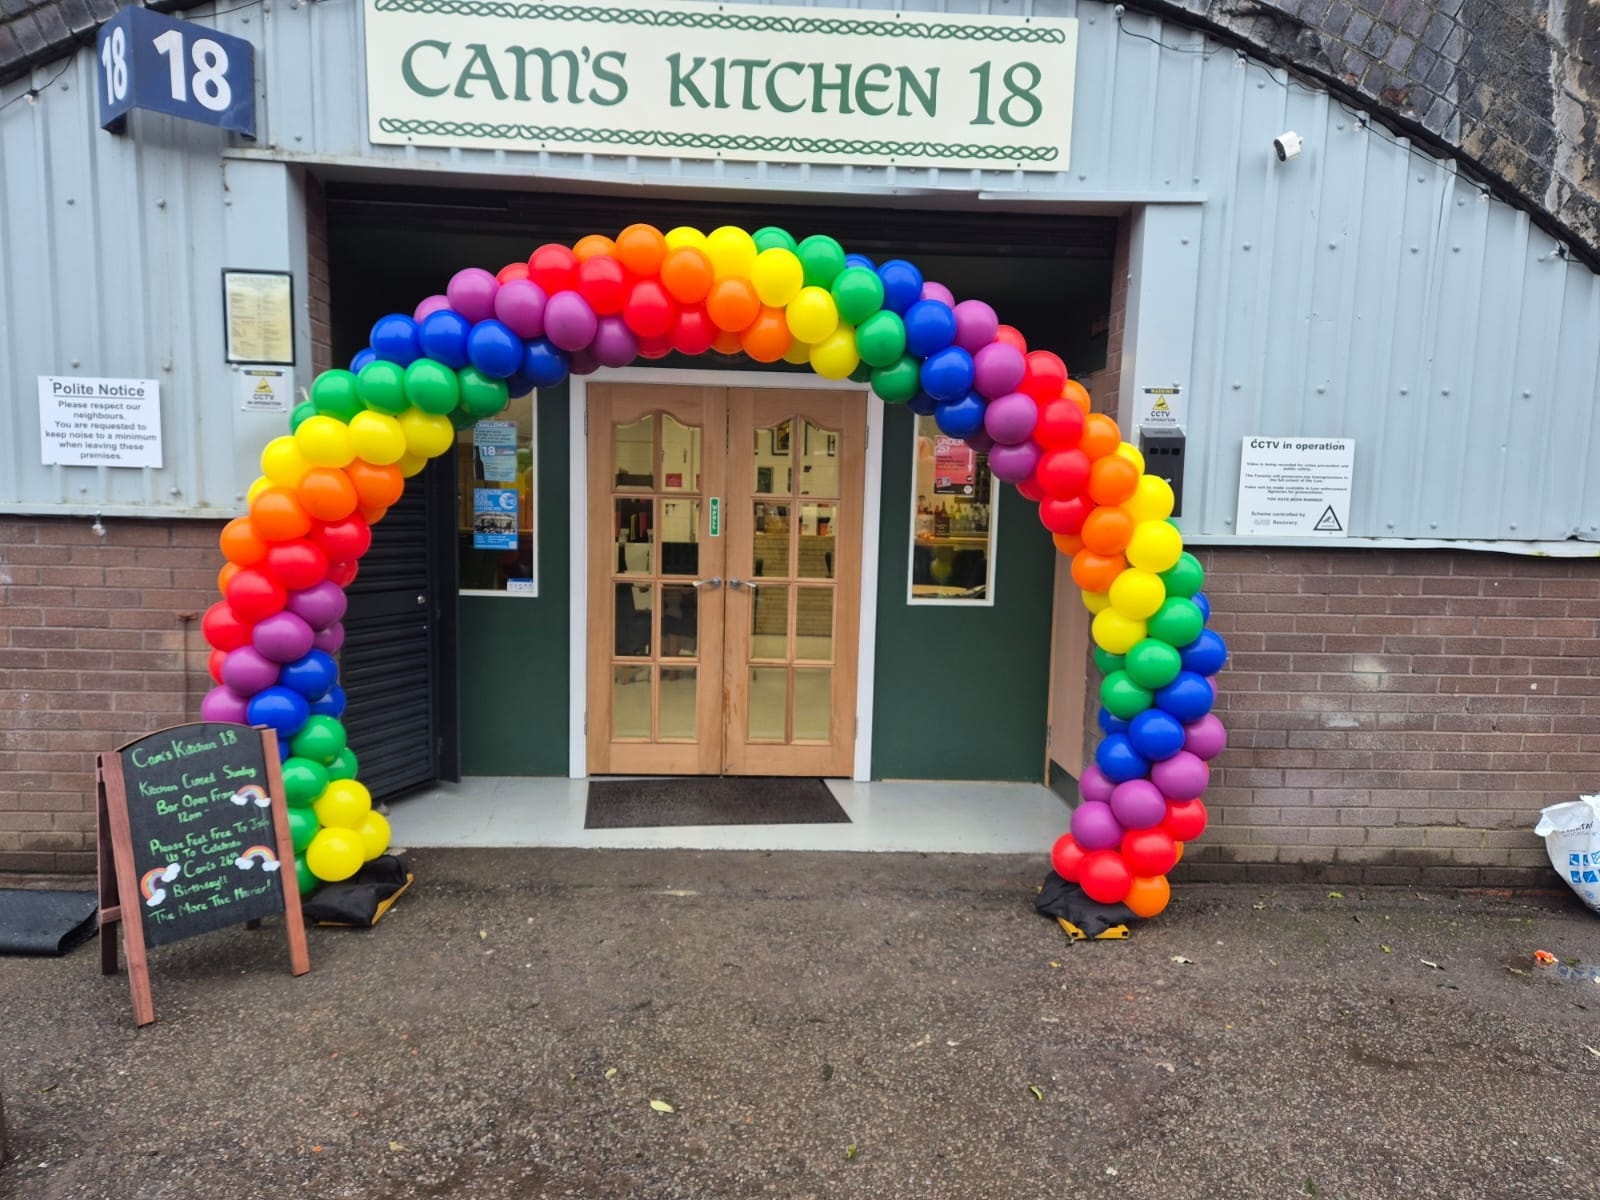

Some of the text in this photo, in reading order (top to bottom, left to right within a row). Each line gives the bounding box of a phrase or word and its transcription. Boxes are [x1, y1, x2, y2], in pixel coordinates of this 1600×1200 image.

[101, 26, 128, 106] 18
[152, 29, 232, 112] 18
[400, 39, 1043, 127] CAM'S KITCHEN 18
[53, 382, 145, 397] Polite Notice
[58, 400, 88, 409] Please
[90, 402, 124, 411] respect
[73, 411, 126, 421] neighbours.
[54, 420, 72, 429] You
[90, 422, 135, 431] requested
[137, 423, 147, 431] to
[45, 430, 67, 439] keep
[69, 431, 94, 439] noise
[115, 433, 157, 441] minimum
[85, 441, 118, 451] leaving
[119, 442, 144, 450] these
[482, 446, 496, 456] 18
[1250, 440, 1345, 451] CCTV in operation
[171, 740, 217, 758] Kitchen
[219, 729, 238, 747] 18
[156, 799, 179, 815] Bar
[181, 794, 209, 807] Open
[149, 838, 185, 856] Please
[209, 826, 233, 840] Free
[232, 820, 248, 833] To
[166, 853, 180, 863] Us
[181, 848, 197, 858] To
[147, 908, 176, 925] The
[178, 901, 209, 917] More
[208, 893, 232, 907] The
